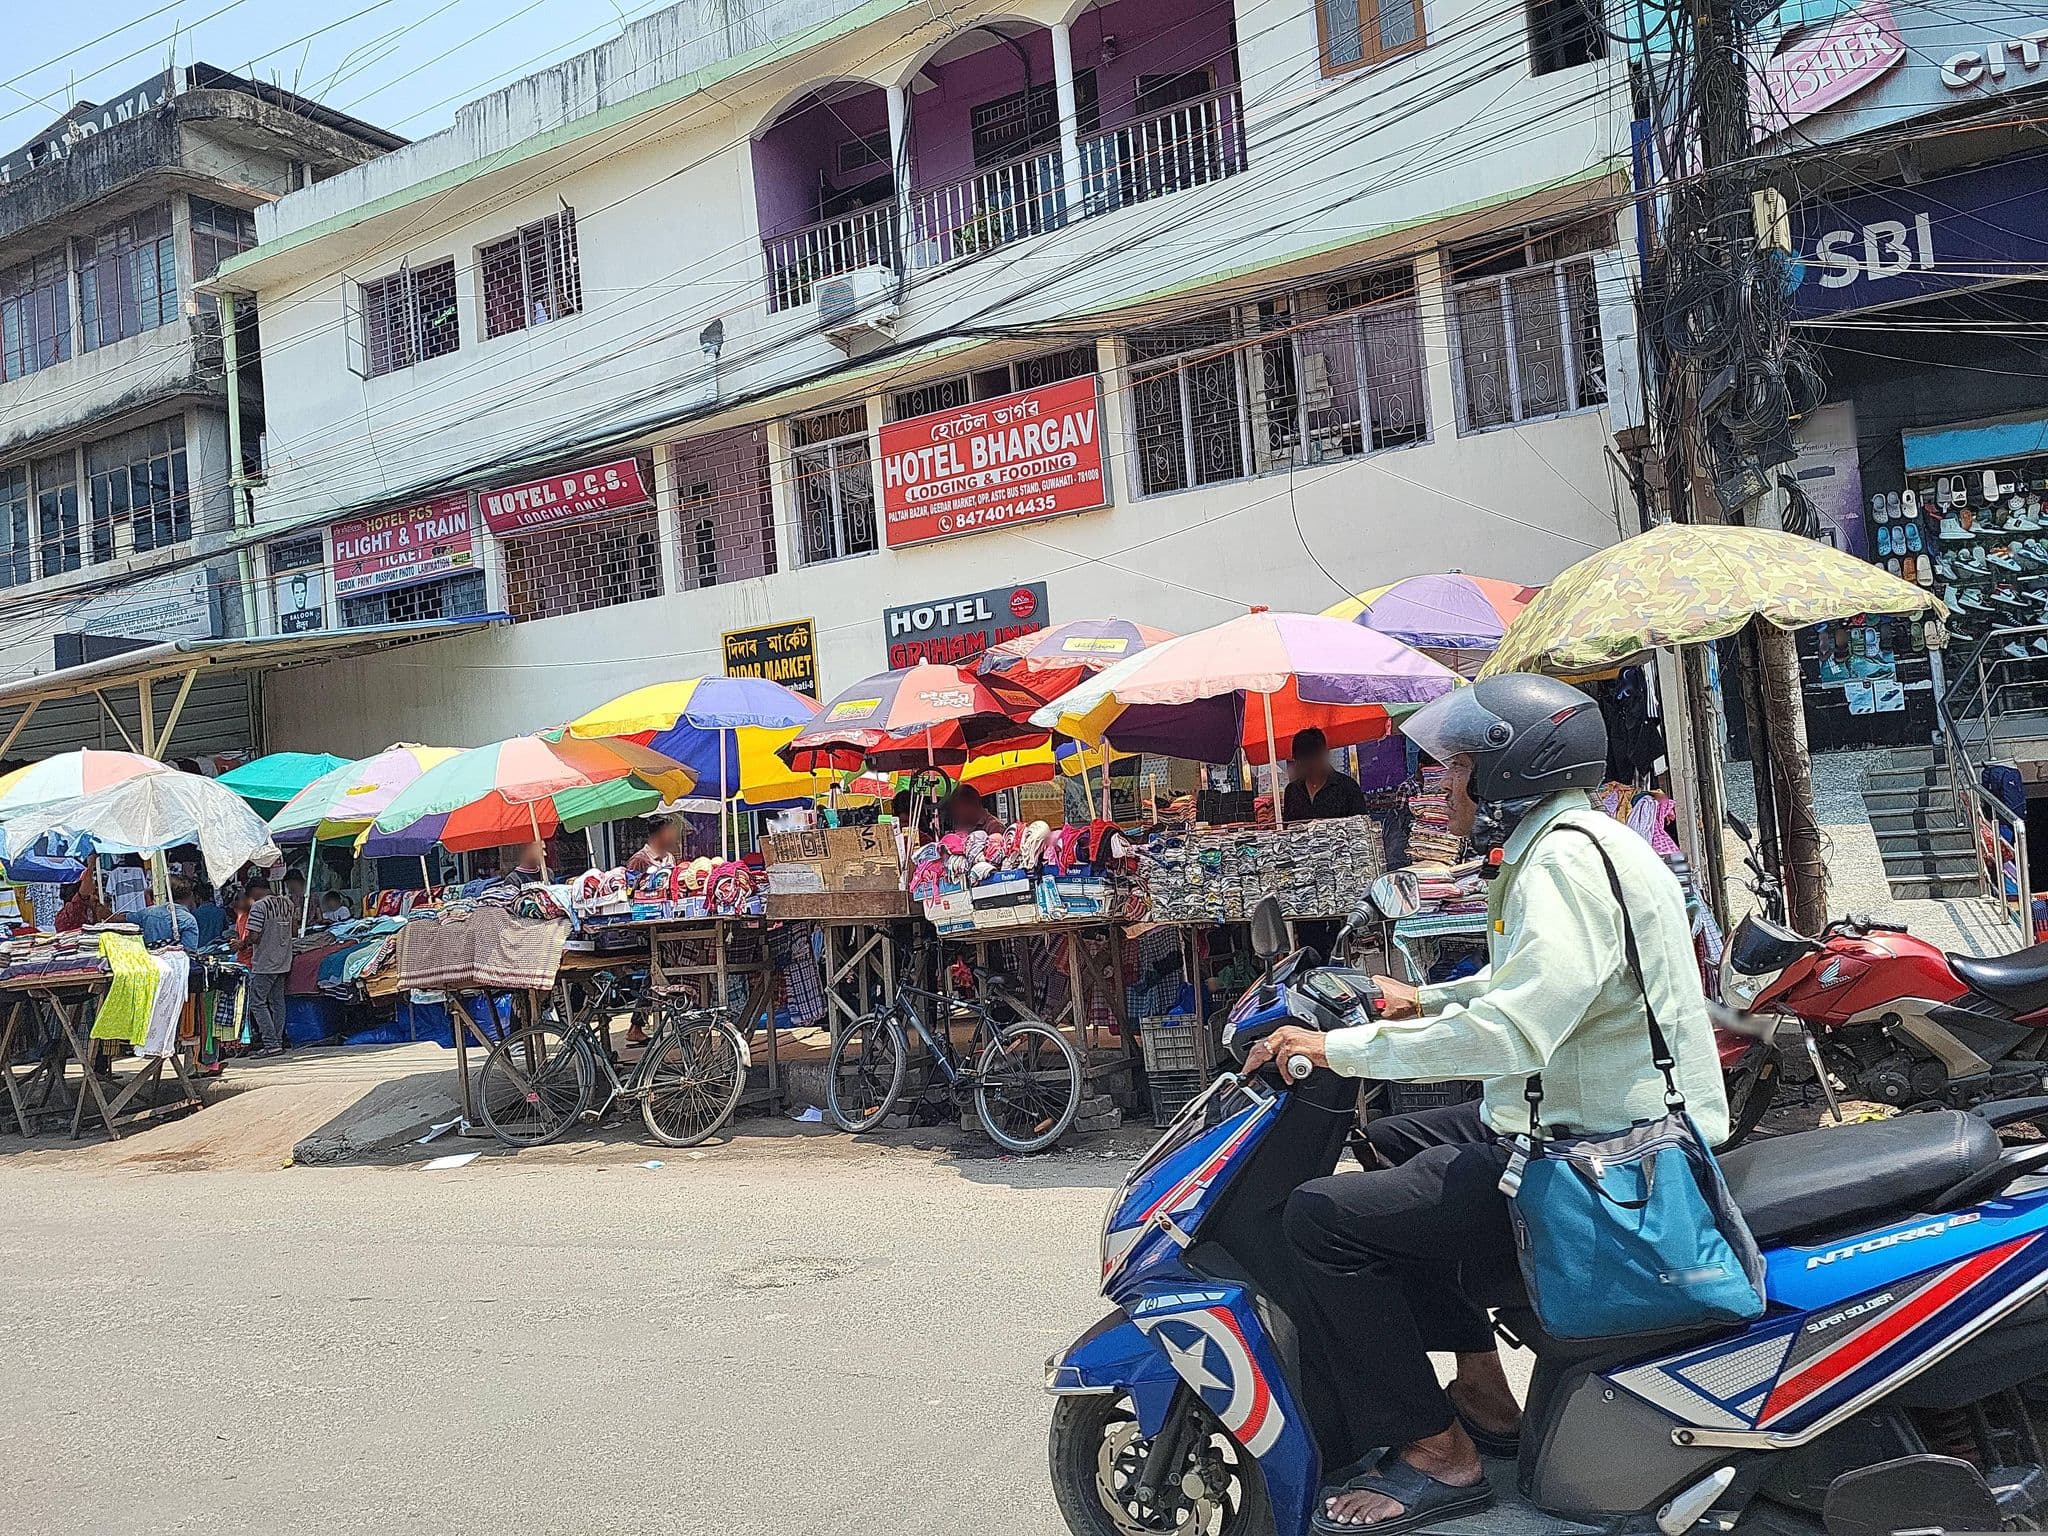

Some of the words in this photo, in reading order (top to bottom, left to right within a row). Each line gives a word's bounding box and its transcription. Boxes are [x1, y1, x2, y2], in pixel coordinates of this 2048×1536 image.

[1816, 212, 1935, 289] SBI
[931, 413, 987, 442] হোটেল
[885, 442, 965, 489] HOTEL
[971, 409, 1094, 470] BHARGAV
[488, 484, 557, 516] HOTEL
[562, 469, 628, 499] P.C.S.
[911, 476, 978, 501] LODGING
[984, 473, 994, 485] &
[1000, 455, 1071, 481] FOODING
[517, 504, 572, 525] LODGING
[576, 497, 609, 512] ONLY
[888, 509, 909, 523] PALTAN
[909, 505, 930, 518] BAZAR,
[952, 496, 977, 511] MARKET,
[977, 493, 991, 504] OPP.
[991, 489, 1006, 501] ASTC
[1007, 486, 1019, 499] BUS
[1020, 481, 1041, 496] STAND,
[1041, 473, 1073, 491] GUWAHATI
[955, 495, 1056, 529] 8474014435
[336, 530, 392, 560] FLIGHT
[398, 527, 410, 546] &
[415, 512, 466, 541] TRAIN
[367, 512, 405, 532] HOTEL
[408, 505, 433, 522] PCS
[337, 579, 355, 592] XEROX
[357, 576, 372, 588] PRINT
[375, 570, 399, 583] PASSPORT
[399, 567, 415, 577] PHOTO
[418, 558, 451, 574] LAMINATION
[379, 549, 423, 568] TICKET
[289, 610, 314, 621] SALOON
[890, 597, 994, 637] HOTEL
[728, 662, 761, 678] DIDAR
[764, 655, 811, 680] MARKET
[889, 630, 987, 669] GRIHAM
[1806, 1222, 1945, 1270] NTORQ
[1806, 1309, 1846, 1334] SUPER
[1845, 1292, 1894, 1319] SOLDIER
